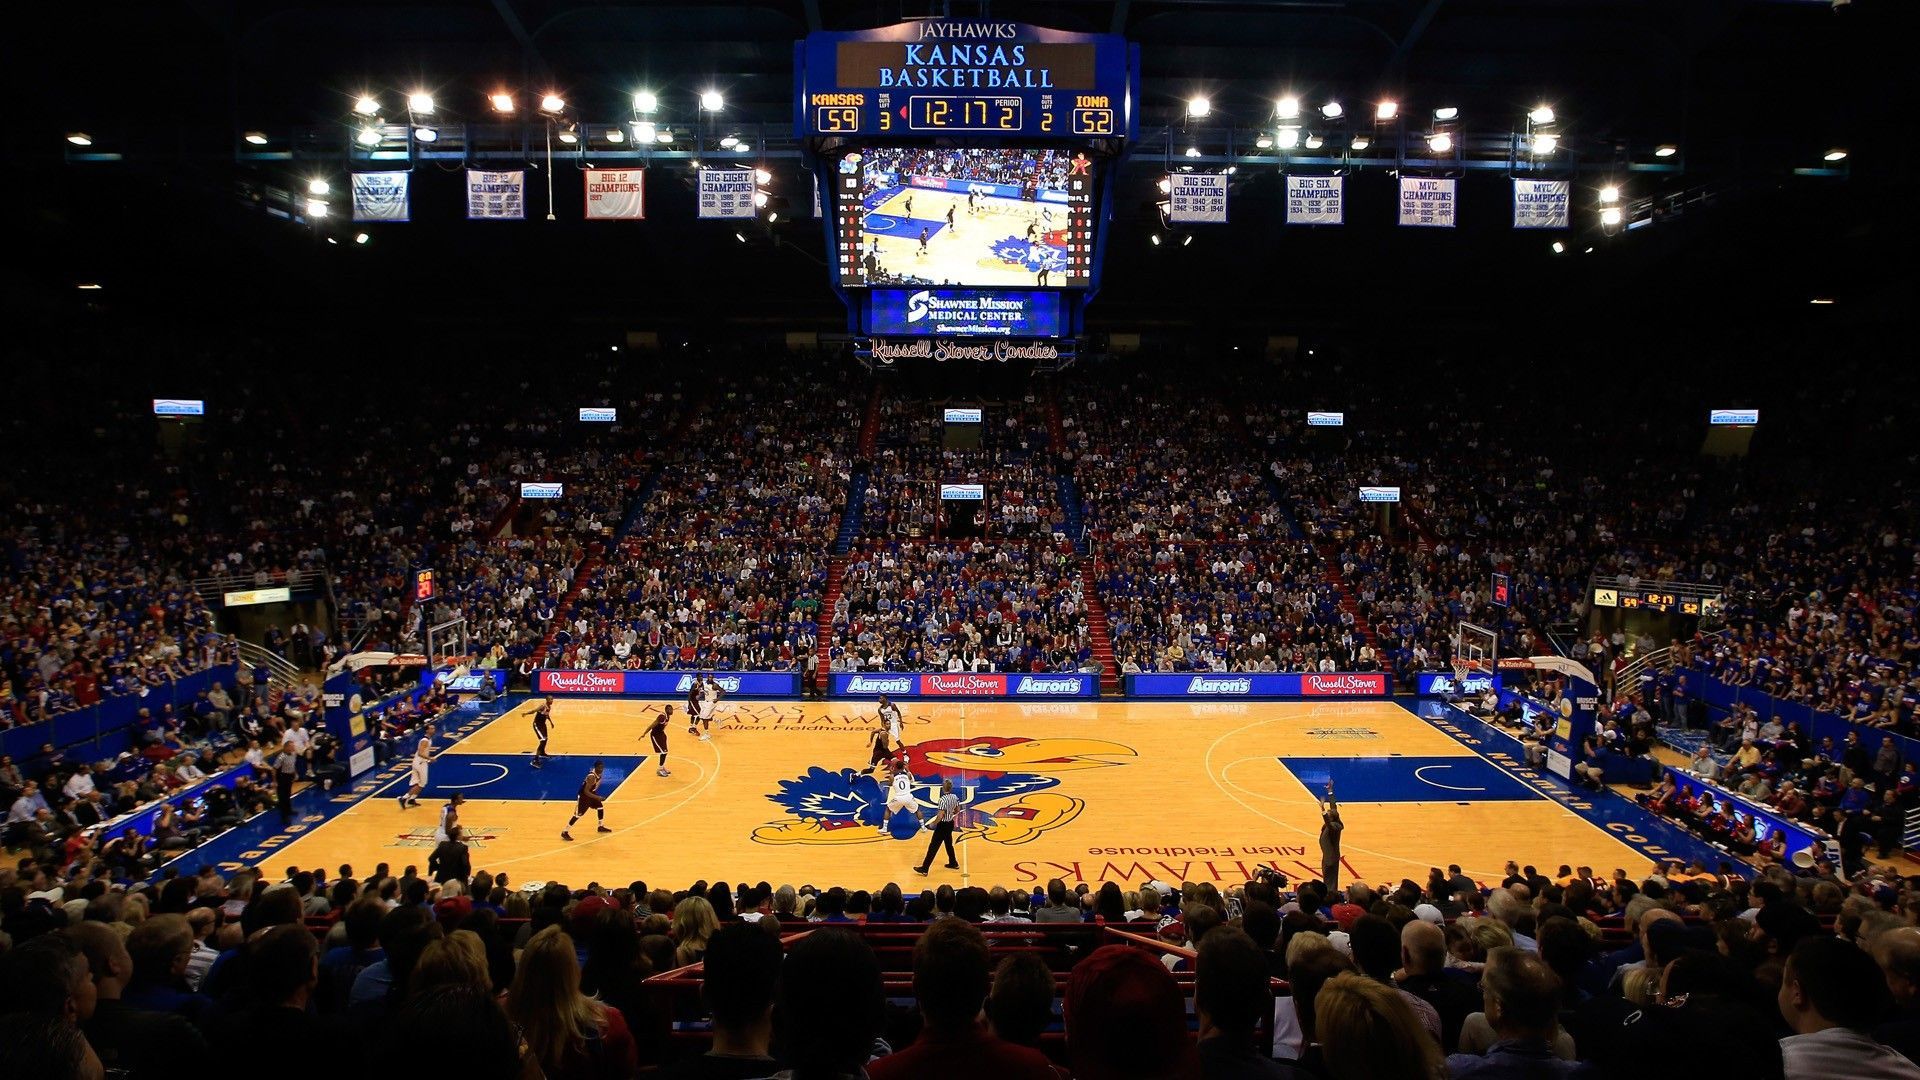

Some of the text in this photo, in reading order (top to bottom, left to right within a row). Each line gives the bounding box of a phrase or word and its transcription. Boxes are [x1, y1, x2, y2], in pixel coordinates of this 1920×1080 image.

[919, 23, 1016, 40] JAYHAWKS
[905, 44, 1025, 66] KANSAS
[880, 68, 1053, 88] BASKETBALL
[812, 94, 864, 106] KANSAS
[995, 99, 1020, 107] PERIOD
[1076, 96, 1109, 107] IONA
[927, 101, 986, 125] 12:17
[1001, 108, 1013, 128] 2
[828, 110, 855, 131] 59
[880, 112, 890, 130] 3
[1041, 113, 1053, 131] 2
[1082, 112, 1109, 132] 52
[602, 174, 628, 182] BIG 12
[705, 173, 749, 182] BIG EIGHT
[1184, 177, 1216, 187] BIG SIX
[471, 184, 520, 193] CHAMPIONS
[590, 183, 640, 192] CHAMPIONS
[702, 183, 752, 193] CHAMPIONS
[1300, 180, 1330, 189] BIG SIX
[1419, 182, 1438, 190] MVC
[1533, 184, 1552, 193] MVC
[1174, 187, 1224, 196] CHAMPIONS
[1290, 190, 1339, 198] CHAMPIONS
[1403, 191, 1452, 200] CHAMPIONS
[1518, 194, 1567, 202] CHAMPIONS
[929, 311, 977, 320] MEDICAL
[936, 324, 1011, 334] ShawneeMission.org
[869, 337, 1058, 364] Russell Stover Candies
[1624, 598, 1637, 608] 59
[1648, 594, 1673, 605] 12:17
[1684, 603, 1698, 614] 52
[547, 672, 617, 689] Russell Stover
[676, 675, 740, 692] An's
[848, 676, 911, 693] Aaron's
[928, 675, 1000, 692] Russell Stover
[1017, 676, 1081, 694] Aaron's
[1187, 676, 1251, 694] Aaron's
[1308, 676, 1377, 692] Russell Stover
[773, 724, 877, 732] Fieldhouse
[898, 780, 906, 790] 0
[1606, 822, 1686, 864] Cour
[1088, 846, 1306, 857] Allen Fieldhouse
